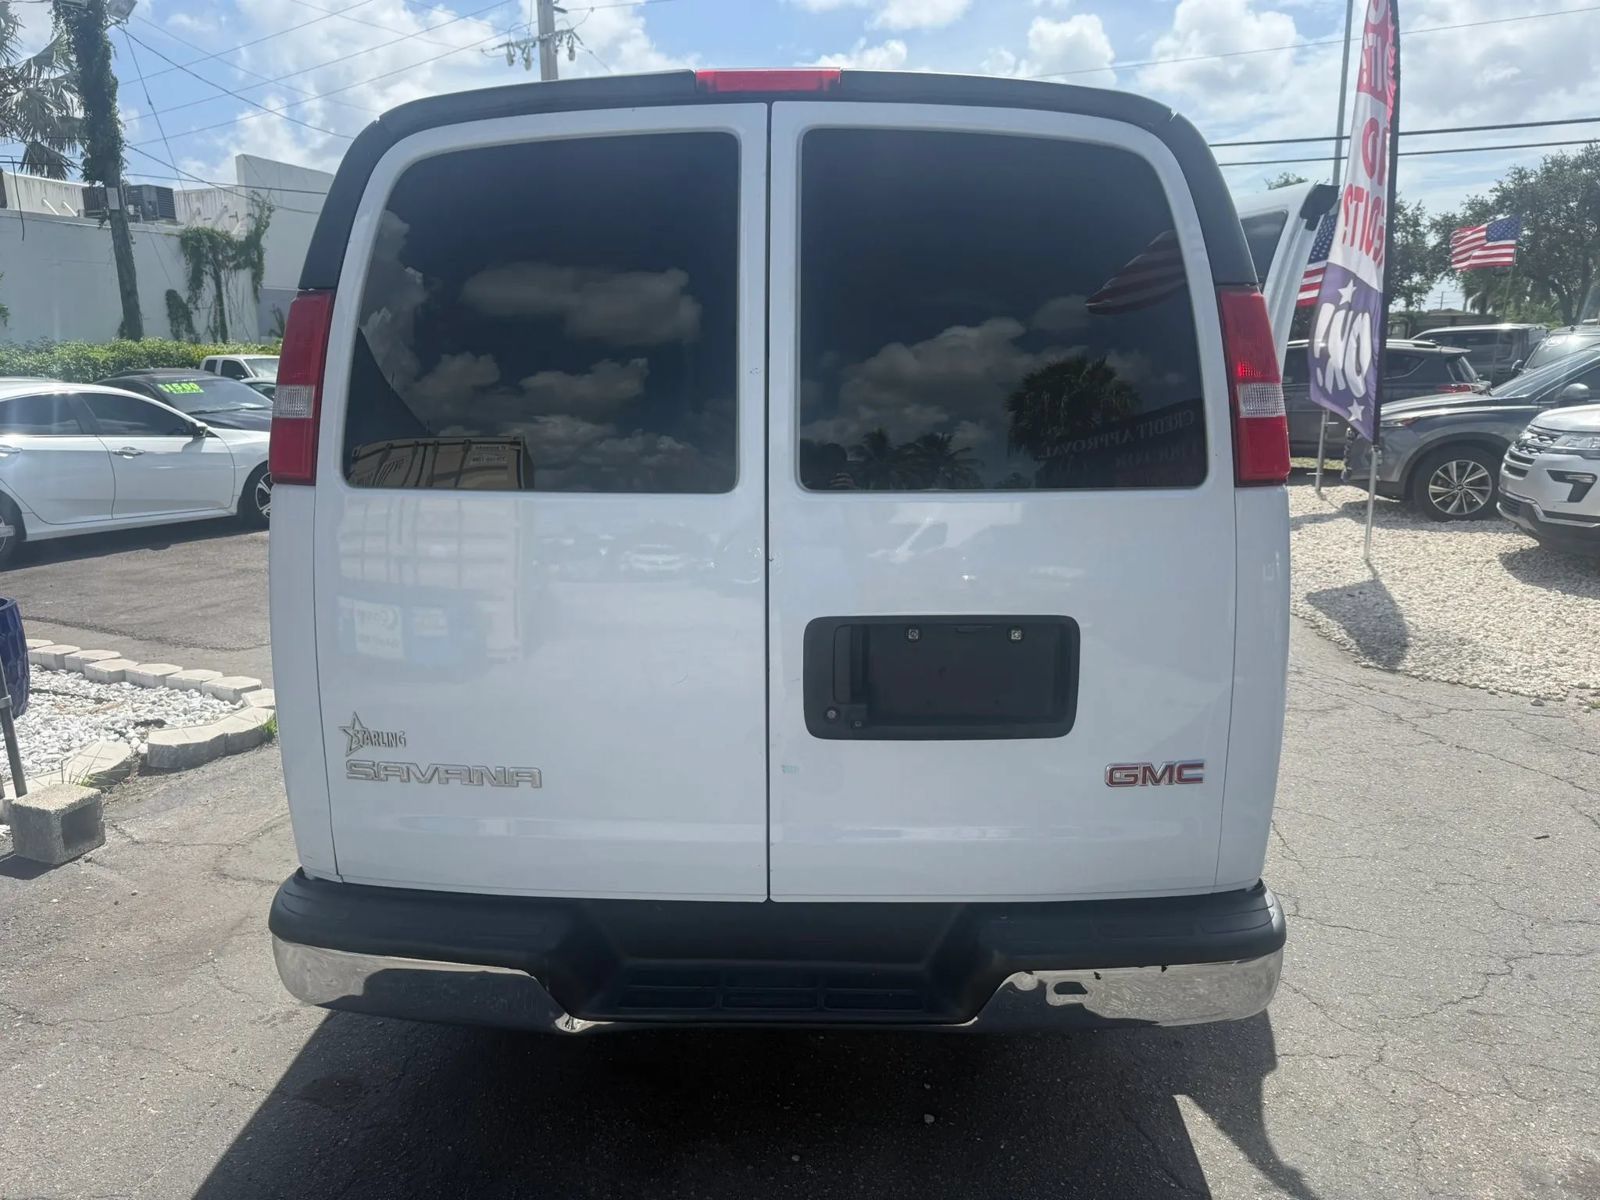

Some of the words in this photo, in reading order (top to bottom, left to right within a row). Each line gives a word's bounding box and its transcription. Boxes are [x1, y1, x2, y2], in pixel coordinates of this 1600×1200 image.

[352, 729, 407, 749] STARLING
[346, 759, 543, 789] SAVANA
[1104, 759, 1206, 788] GMC
